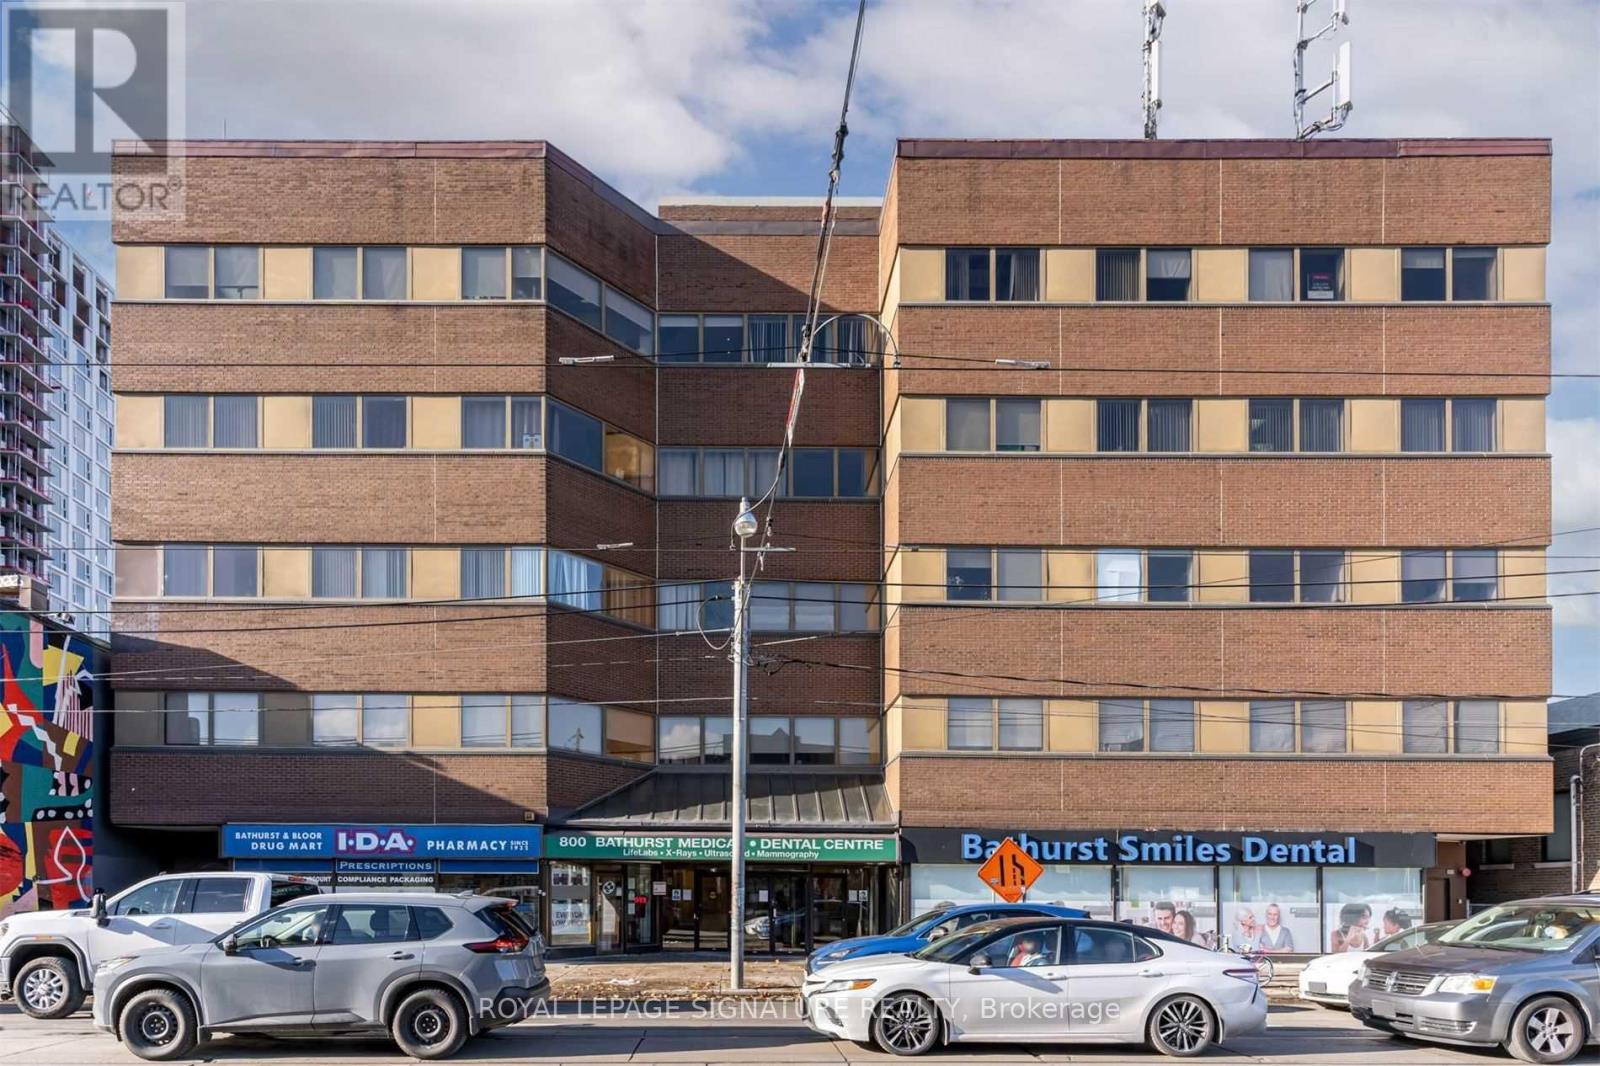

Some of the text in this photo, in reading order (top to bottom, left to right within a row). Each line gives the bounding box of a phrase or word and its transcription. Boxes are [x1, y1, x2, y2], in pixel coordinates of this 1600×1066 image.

[235, 832, 322, 840] BATHURST & BLOOR
[251, 842, 323, 850] DRUG MART
[427, 840, 507, 851] PHARMACY
[559, 836, 884, 850] 800 BATHURST MEDICA DENTAL CENTRE
[962, 832, 1357, 864] Bahurst Smiles Dental
[623, 848, 658, 857] LifeLabs
[665, 849, 698, 858] X-Rays
[756, 849, 819, 860] Mammography
